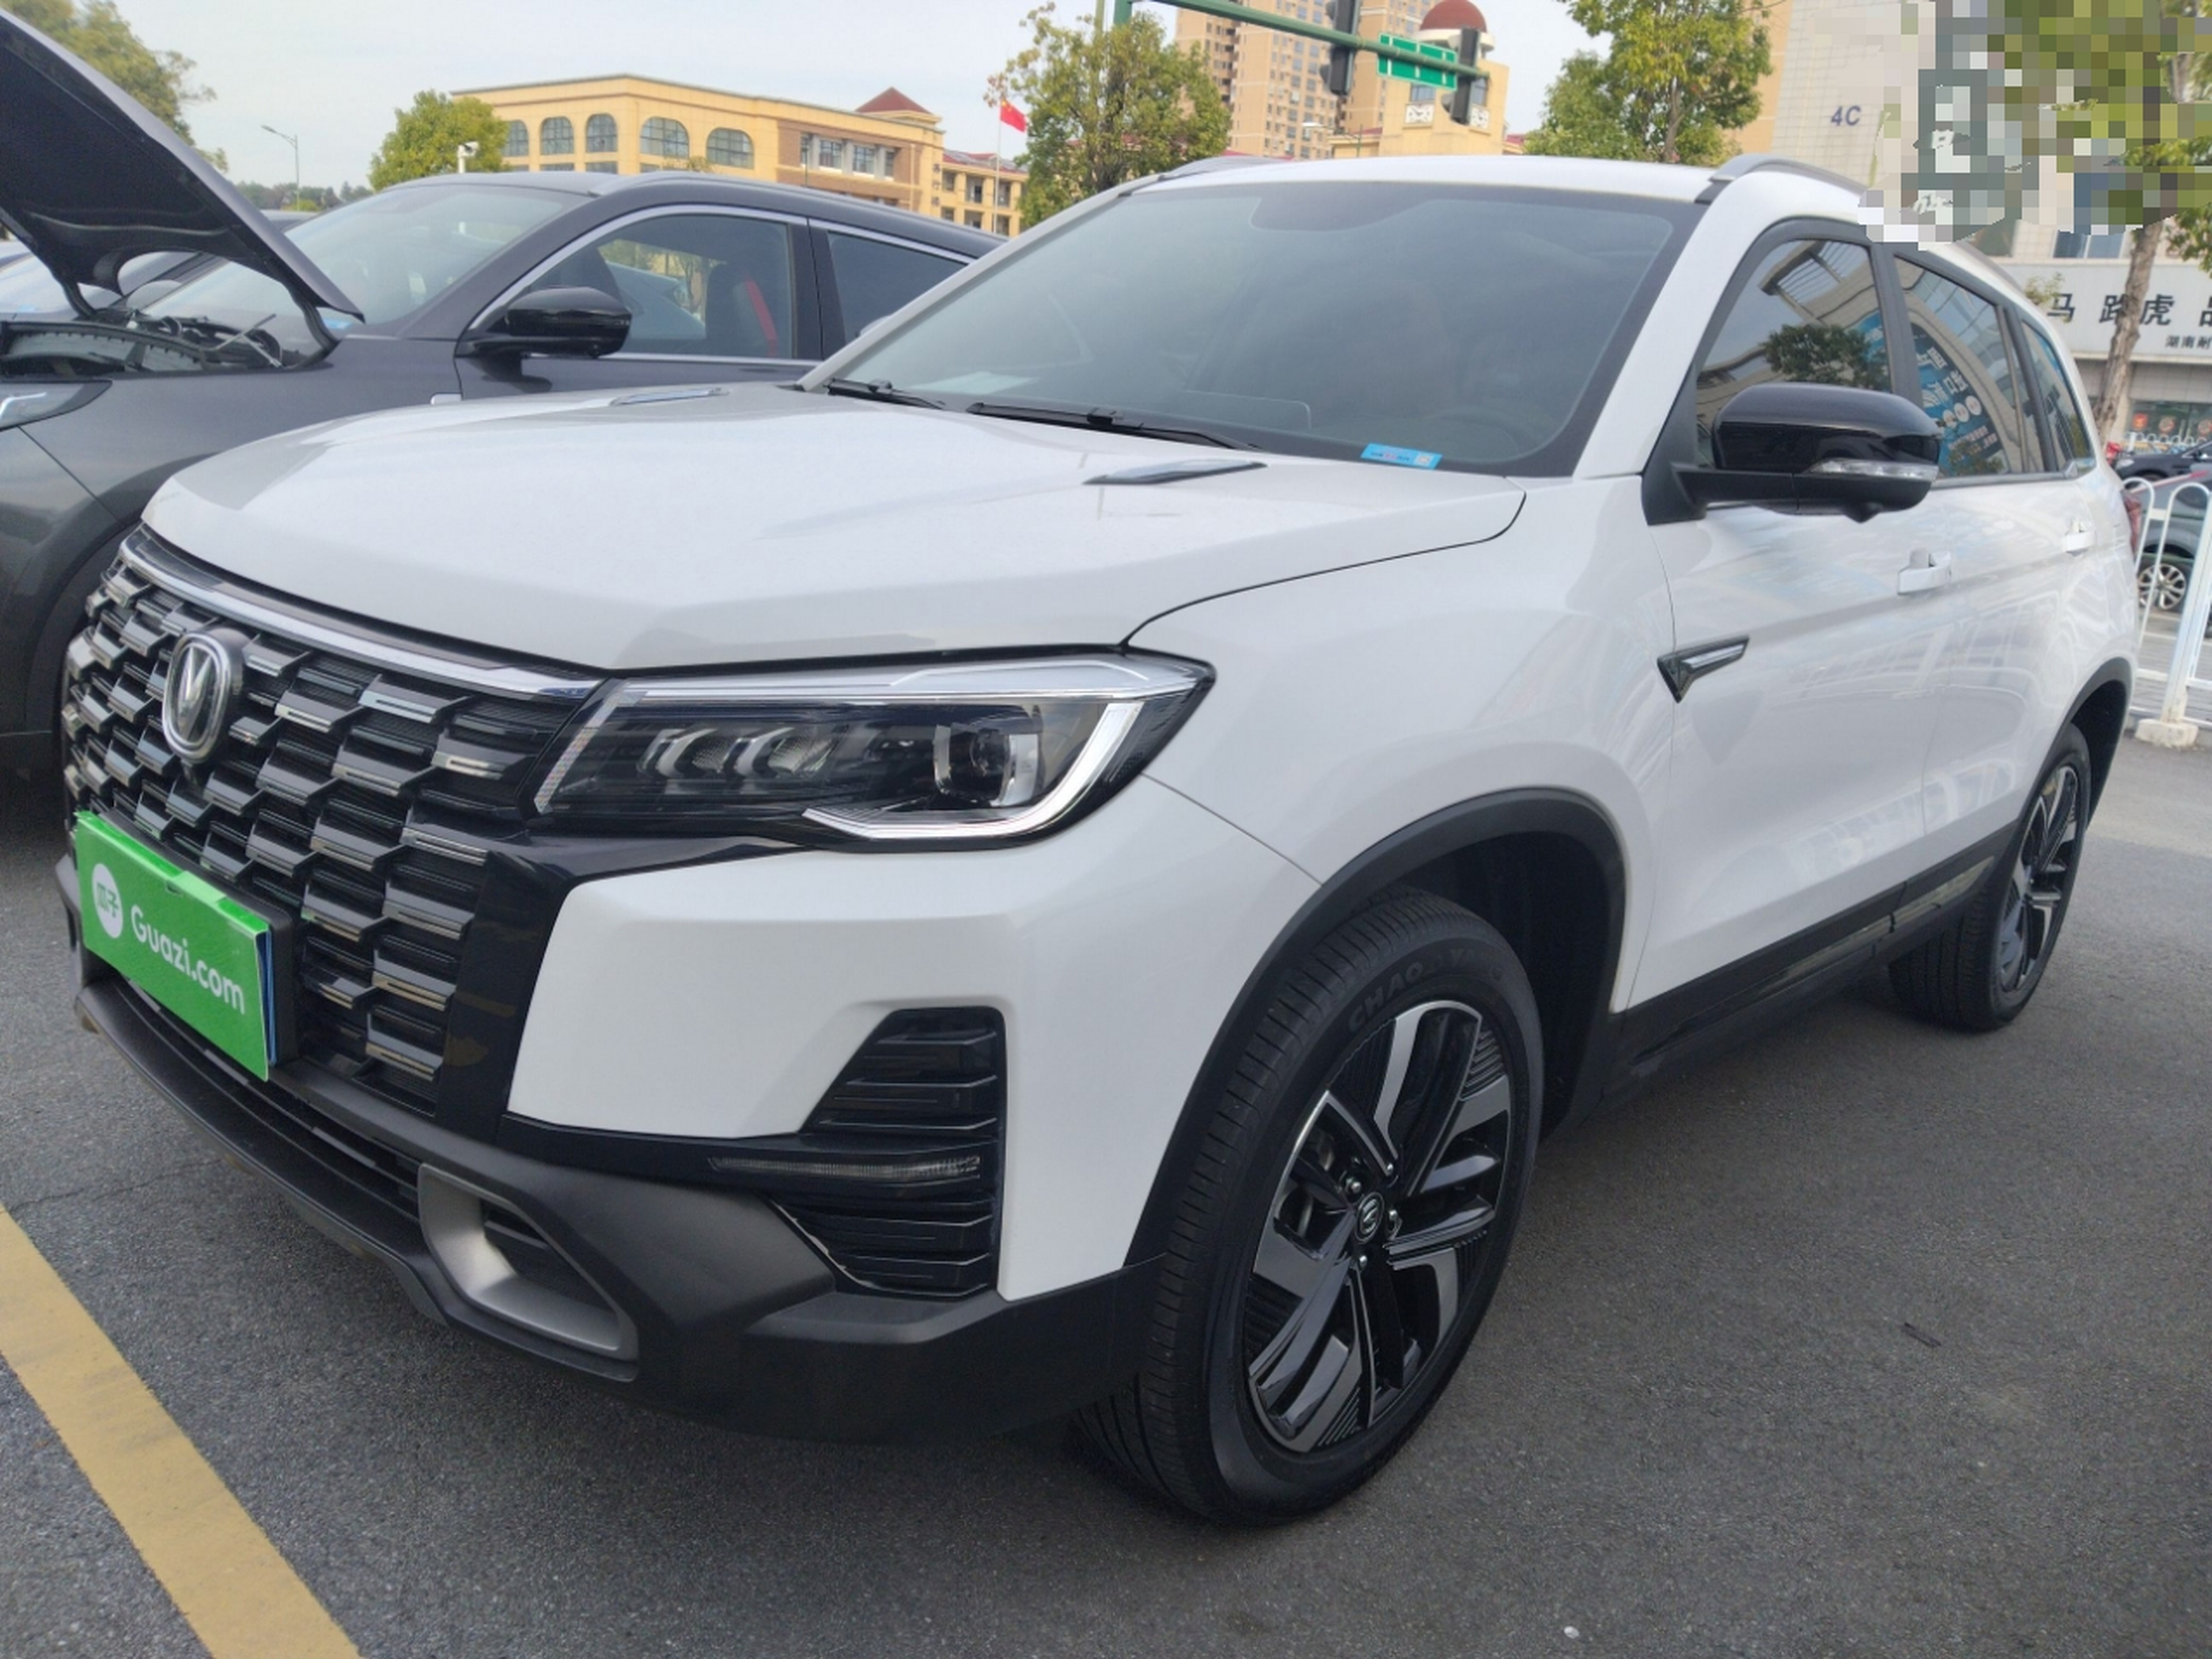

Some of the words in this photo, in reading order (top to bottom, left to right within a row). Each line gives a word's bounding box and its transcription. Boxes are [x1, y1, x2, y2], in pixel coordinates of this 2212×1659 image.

[1831, 105, 1861, 126] 4C
[131, 904, 245, 1015] Guazi.com
[1349, 962, 1423, 1031] CHAO
